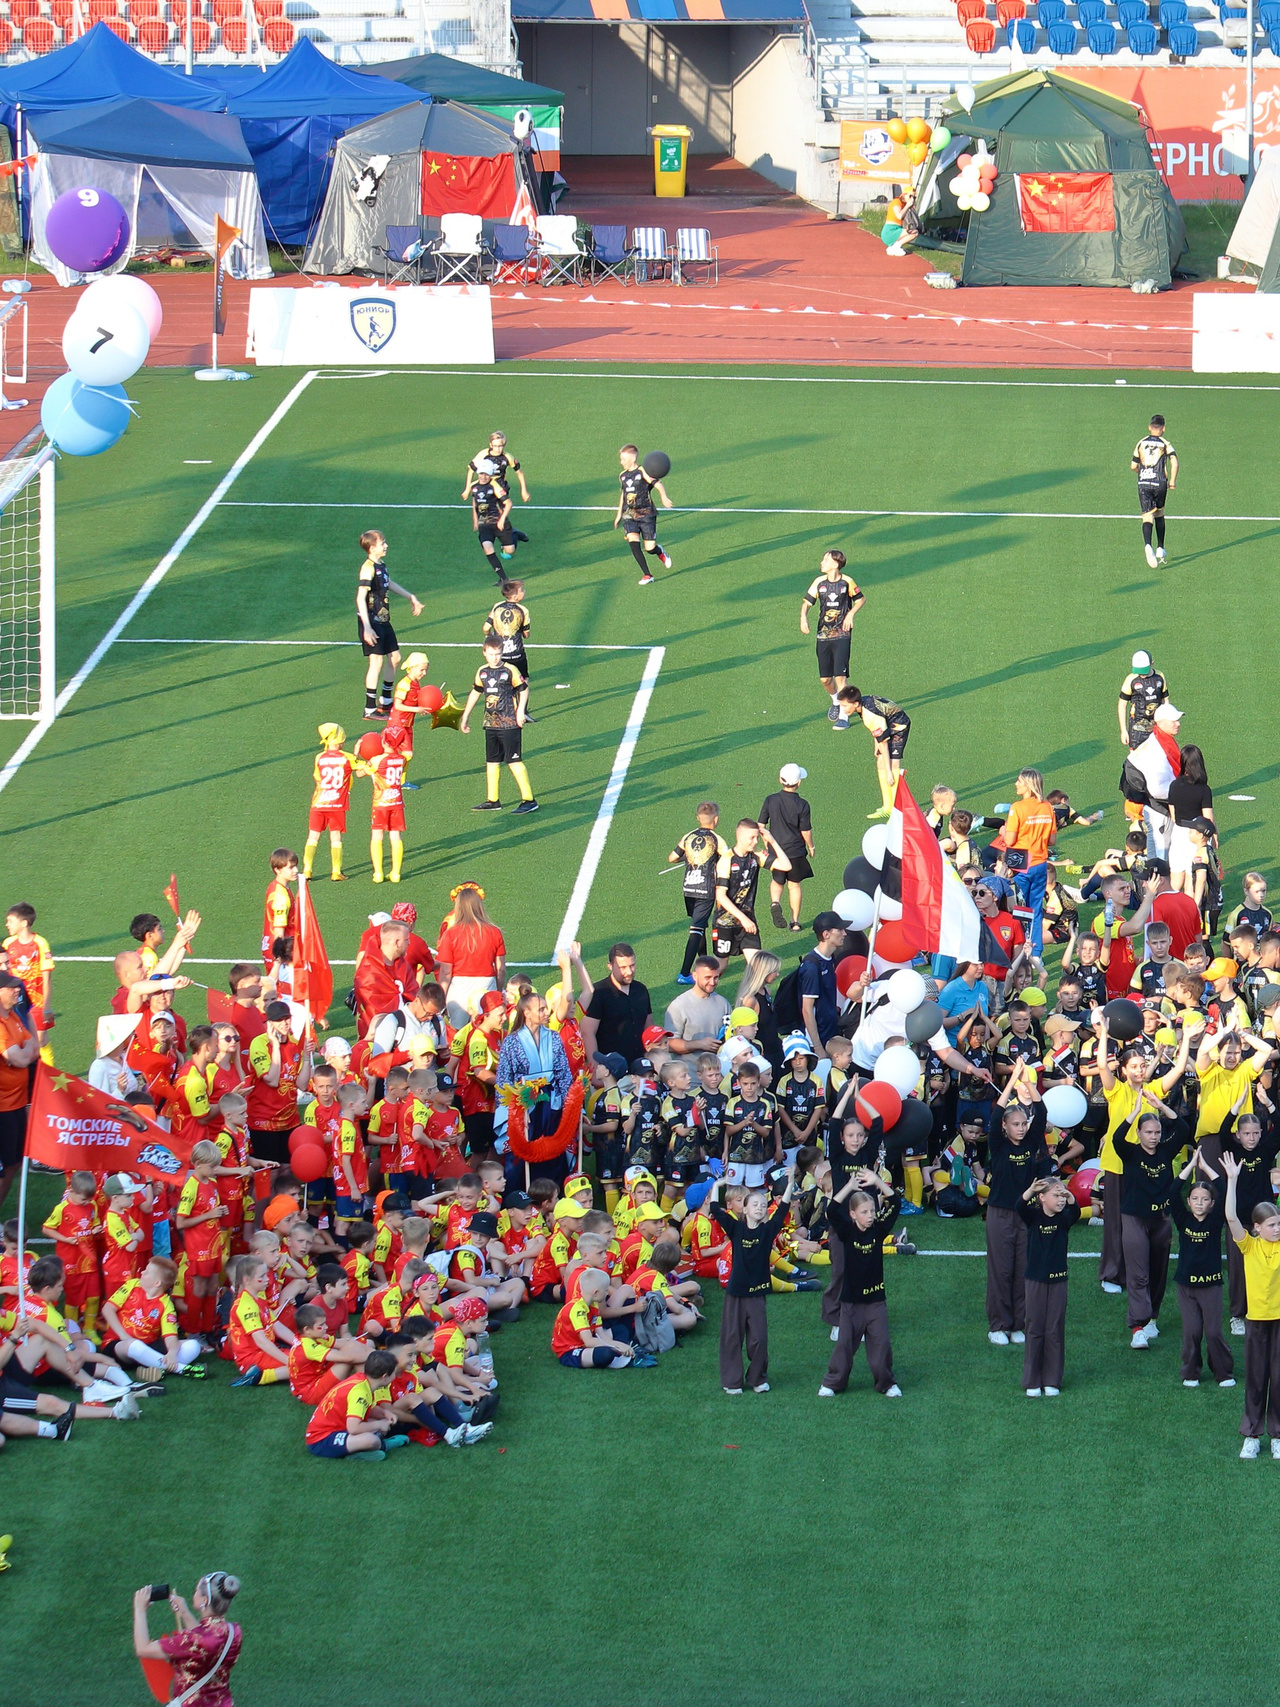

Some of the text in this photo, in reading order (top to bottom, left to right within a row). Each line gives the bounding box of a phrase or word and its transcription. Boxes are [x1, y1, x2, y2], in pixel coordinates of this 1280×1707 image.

[77, 188, 99, 208] 9
[356, 306, 390, 315] ЮНИОР
[89, 326, 115, 355] 7
[321, 767, 345, 789] 28
[385, 766, 403, 786] 99
[717, 939, 731, 953] 50
[47, 1114, 122, 1133] ТОМСКИЕ
[57, 1131, 130, 1147] ЯСТРЕБЫ
[1190, 1272, 1222, 1283] DANCE
[749, 1282, 770, 1293] DANCE
